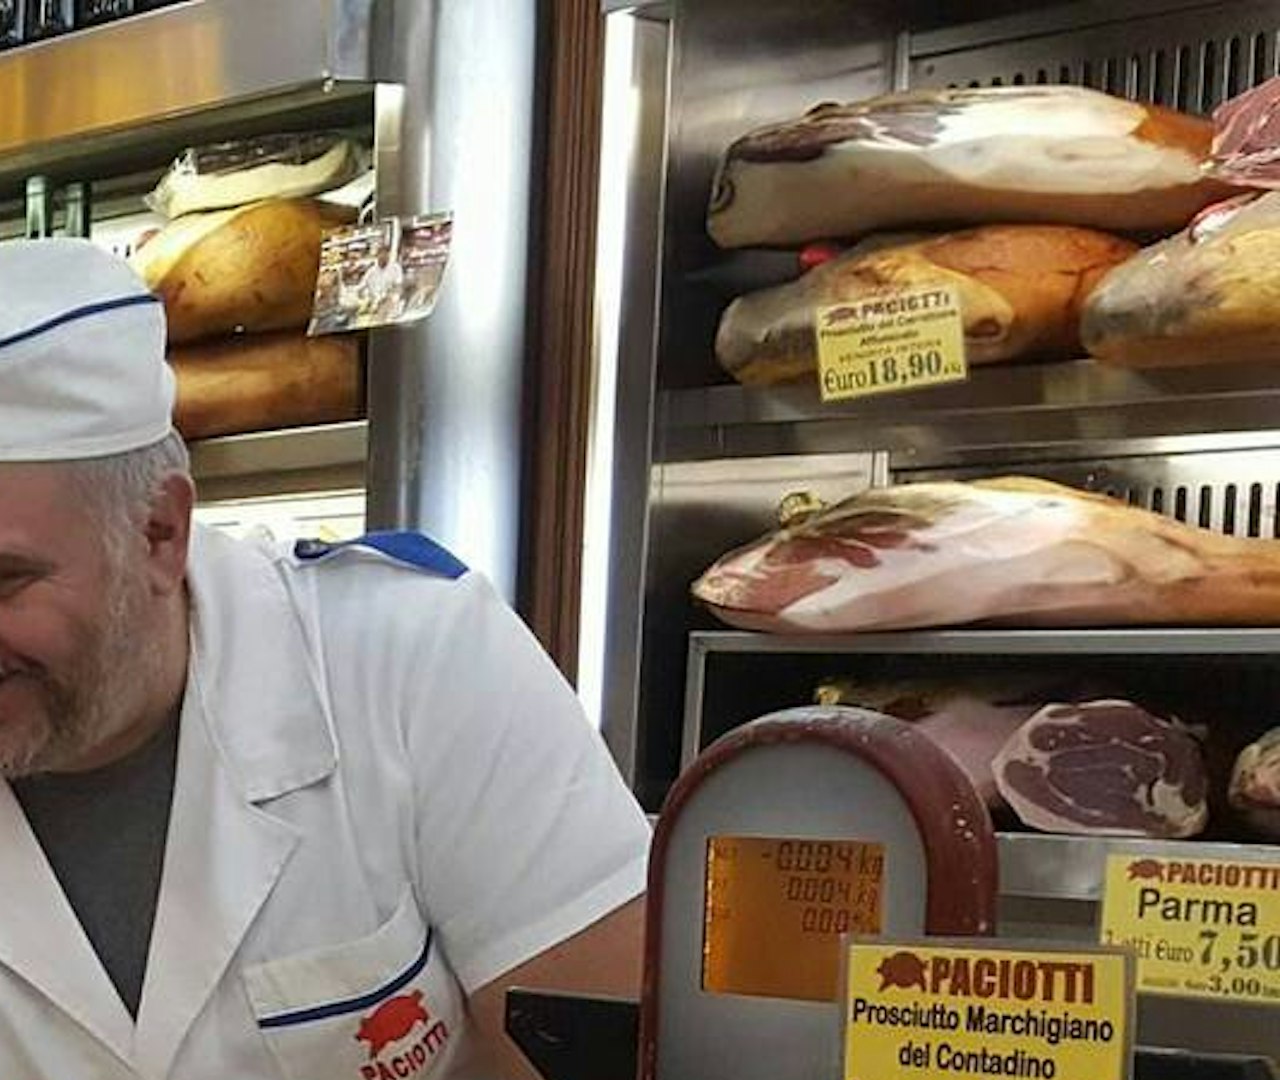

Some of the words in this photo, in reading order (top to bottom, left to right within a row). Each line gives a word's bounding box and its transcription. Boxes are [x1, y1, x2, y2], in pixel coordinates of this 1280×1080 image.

[1167, 861, 1279, 890] PACIOTTI
[1138, 888, 1257, 926] Parma
[1199, 930, 1280, 972] 7,50
[930, 956, 1094, 1004] PACIOTTI
[852, 998, 959, 1031] Prosciutto
[966, 1005, 1113, 1046] Marchigiano
[899, 1041, 930, 1069] del
[936, 1043, 1056, 1080] Contadino
